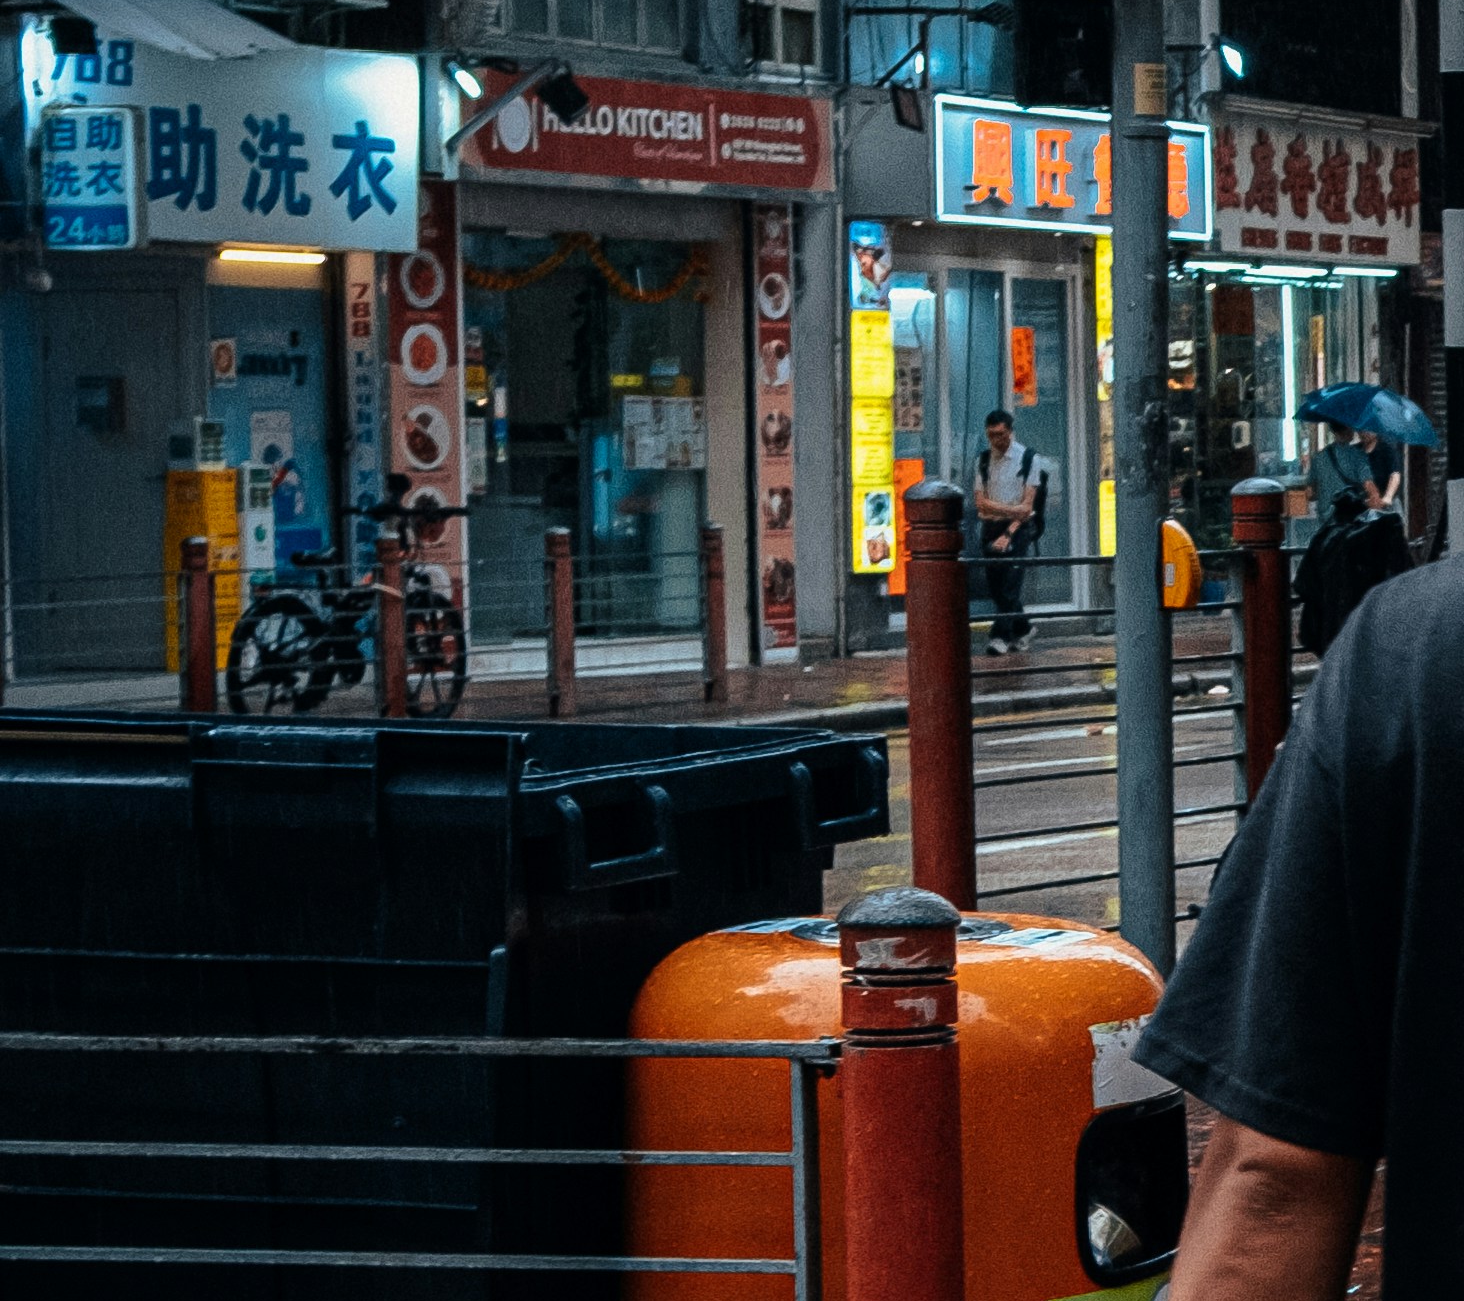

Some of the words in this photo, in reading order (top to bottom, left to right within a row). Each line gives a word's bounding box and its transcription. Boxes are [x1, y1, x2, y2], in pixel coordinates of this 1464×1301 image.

[617, 107, 703, 141] KITCHEN
[44, 161, 124, 197] 洗衣
[147, 103, 398, 222] 助洗衣
